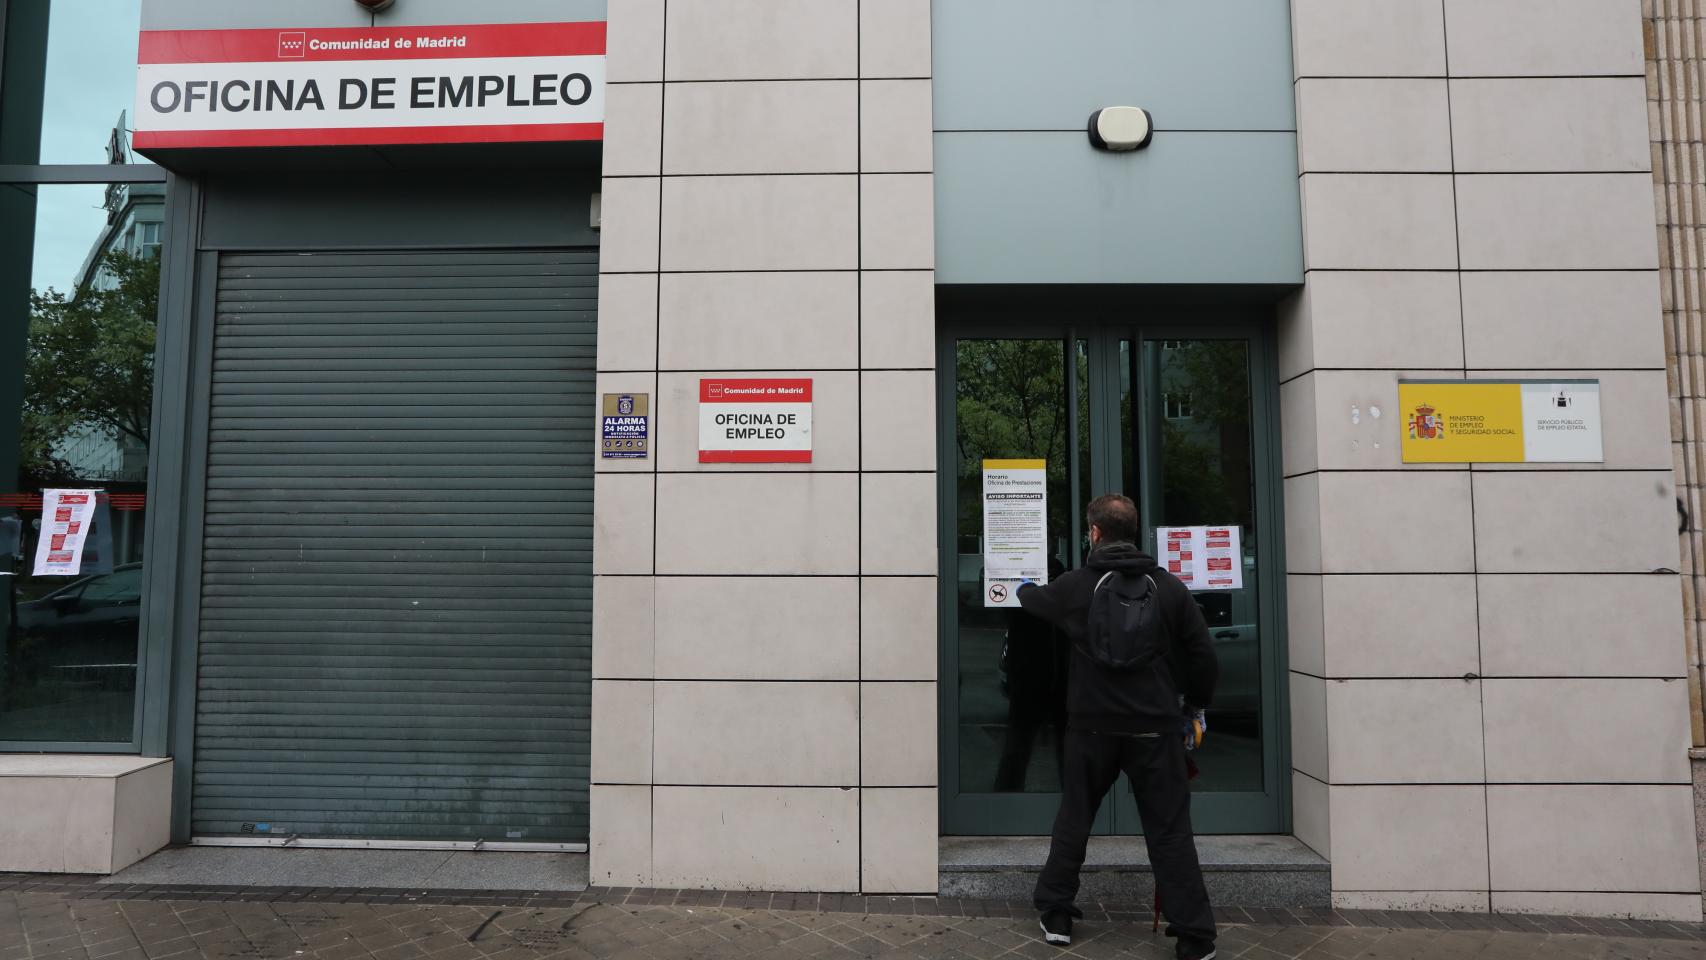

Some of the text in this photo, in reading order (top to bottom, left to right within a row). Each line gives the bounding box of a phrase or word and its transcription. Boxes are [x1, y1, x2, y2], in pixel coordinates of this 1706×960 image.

[309, 36, 467, 51] Comunidad de Madrid
[149, 72, 593, 114] OFICINA DE EMPLEO
[605, 417, 645, 425] ALARMA
[715, 413, 796, 425] OFICINA DE
[726, 427, 785, 439] EMPLEO
